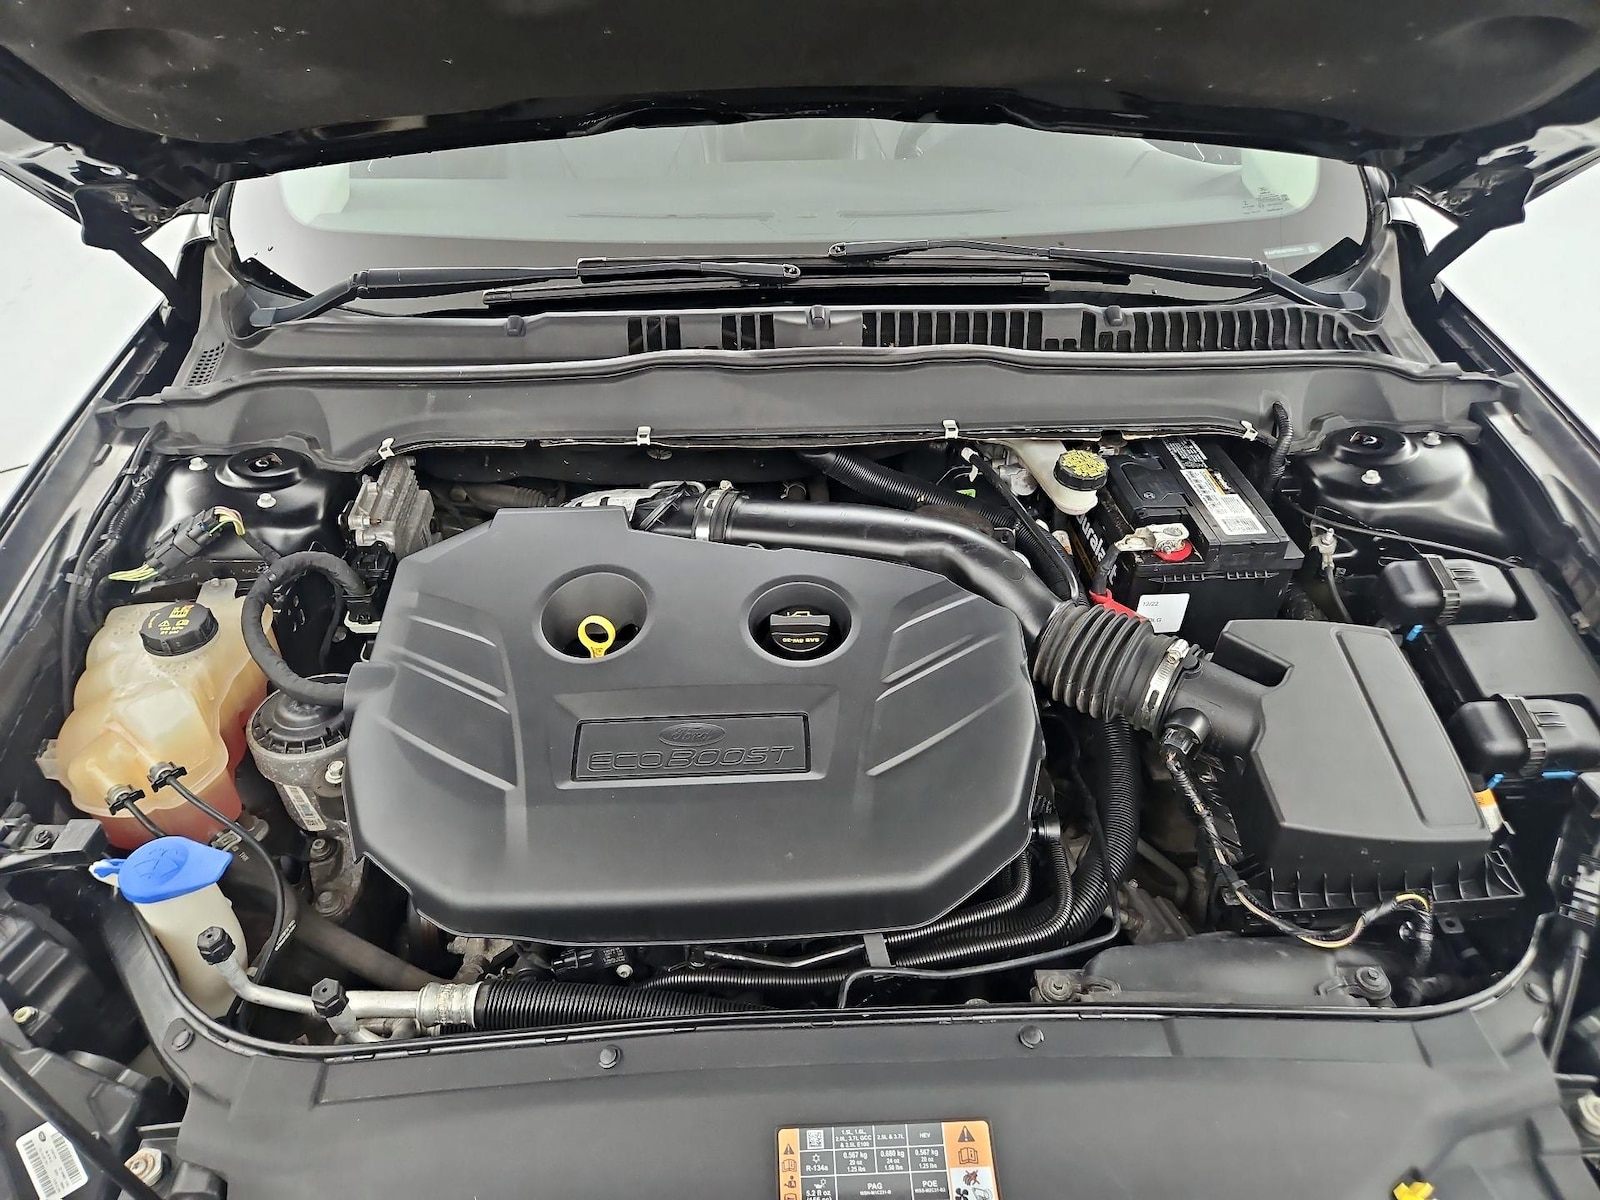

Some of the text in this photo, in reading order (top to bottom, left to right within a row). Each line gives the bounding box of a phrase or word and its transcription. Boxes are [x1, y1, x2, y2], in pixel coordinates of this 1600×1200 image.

[860, 1151, 868, 1160] kg
[896, 1150, 905, 1158] kg
[930, 1149, 939, 1157] kg
[805, 1164, 829, 1172] R-134a
[867, 1182, 883, 1190] PAG
[922, 1179, 938, 1188] POE
[805, 1189, 816, 1197] 5.2
